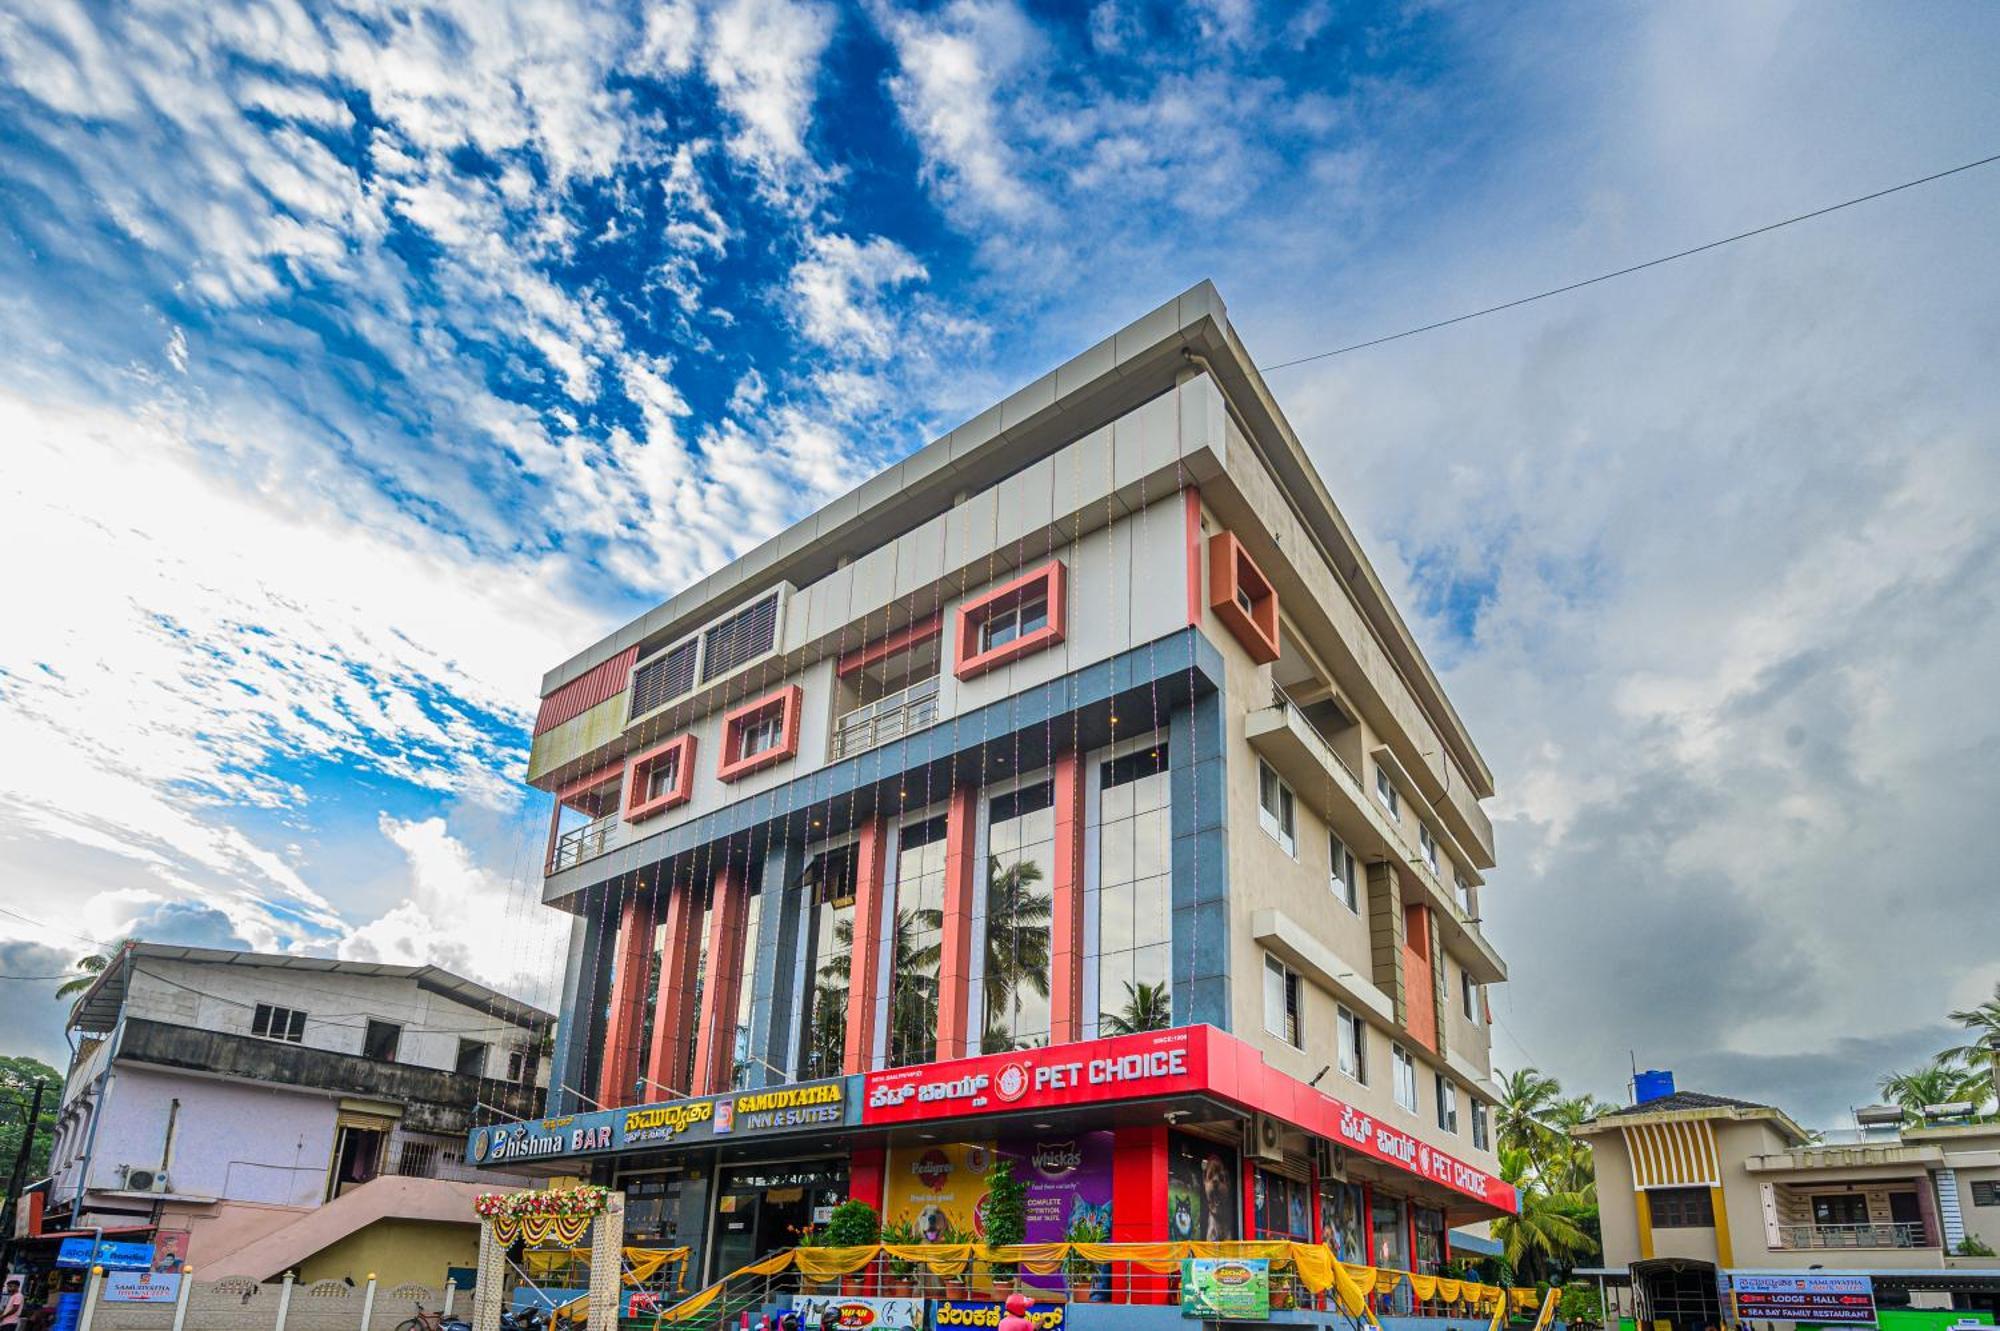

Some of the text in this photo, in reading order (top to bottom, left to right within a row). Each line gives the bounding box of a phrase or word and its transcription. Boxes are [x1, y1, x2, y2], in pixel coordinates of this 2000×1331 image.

[1035, 1049, 1187, 1091] PET CHOICE
[738, 1084, 842, 1113] SAMUDYATHA
[748, 1111, 772, 1129] INN
[786, 1105, 838, 1126] SUITES
[491, 1126, 612, 1158] Bhishma BAR
[1433, 1152, 1488, 1198] PET CHOICE
[1027, 1198, 1062, 1206] COMPLETE
[1772, 1294, 1839, 1304] LODGE HALL
[1782, 1309, 1811, 1317] FAMILY
[1813, 1309, 1868, 1318] RESTAURANT
